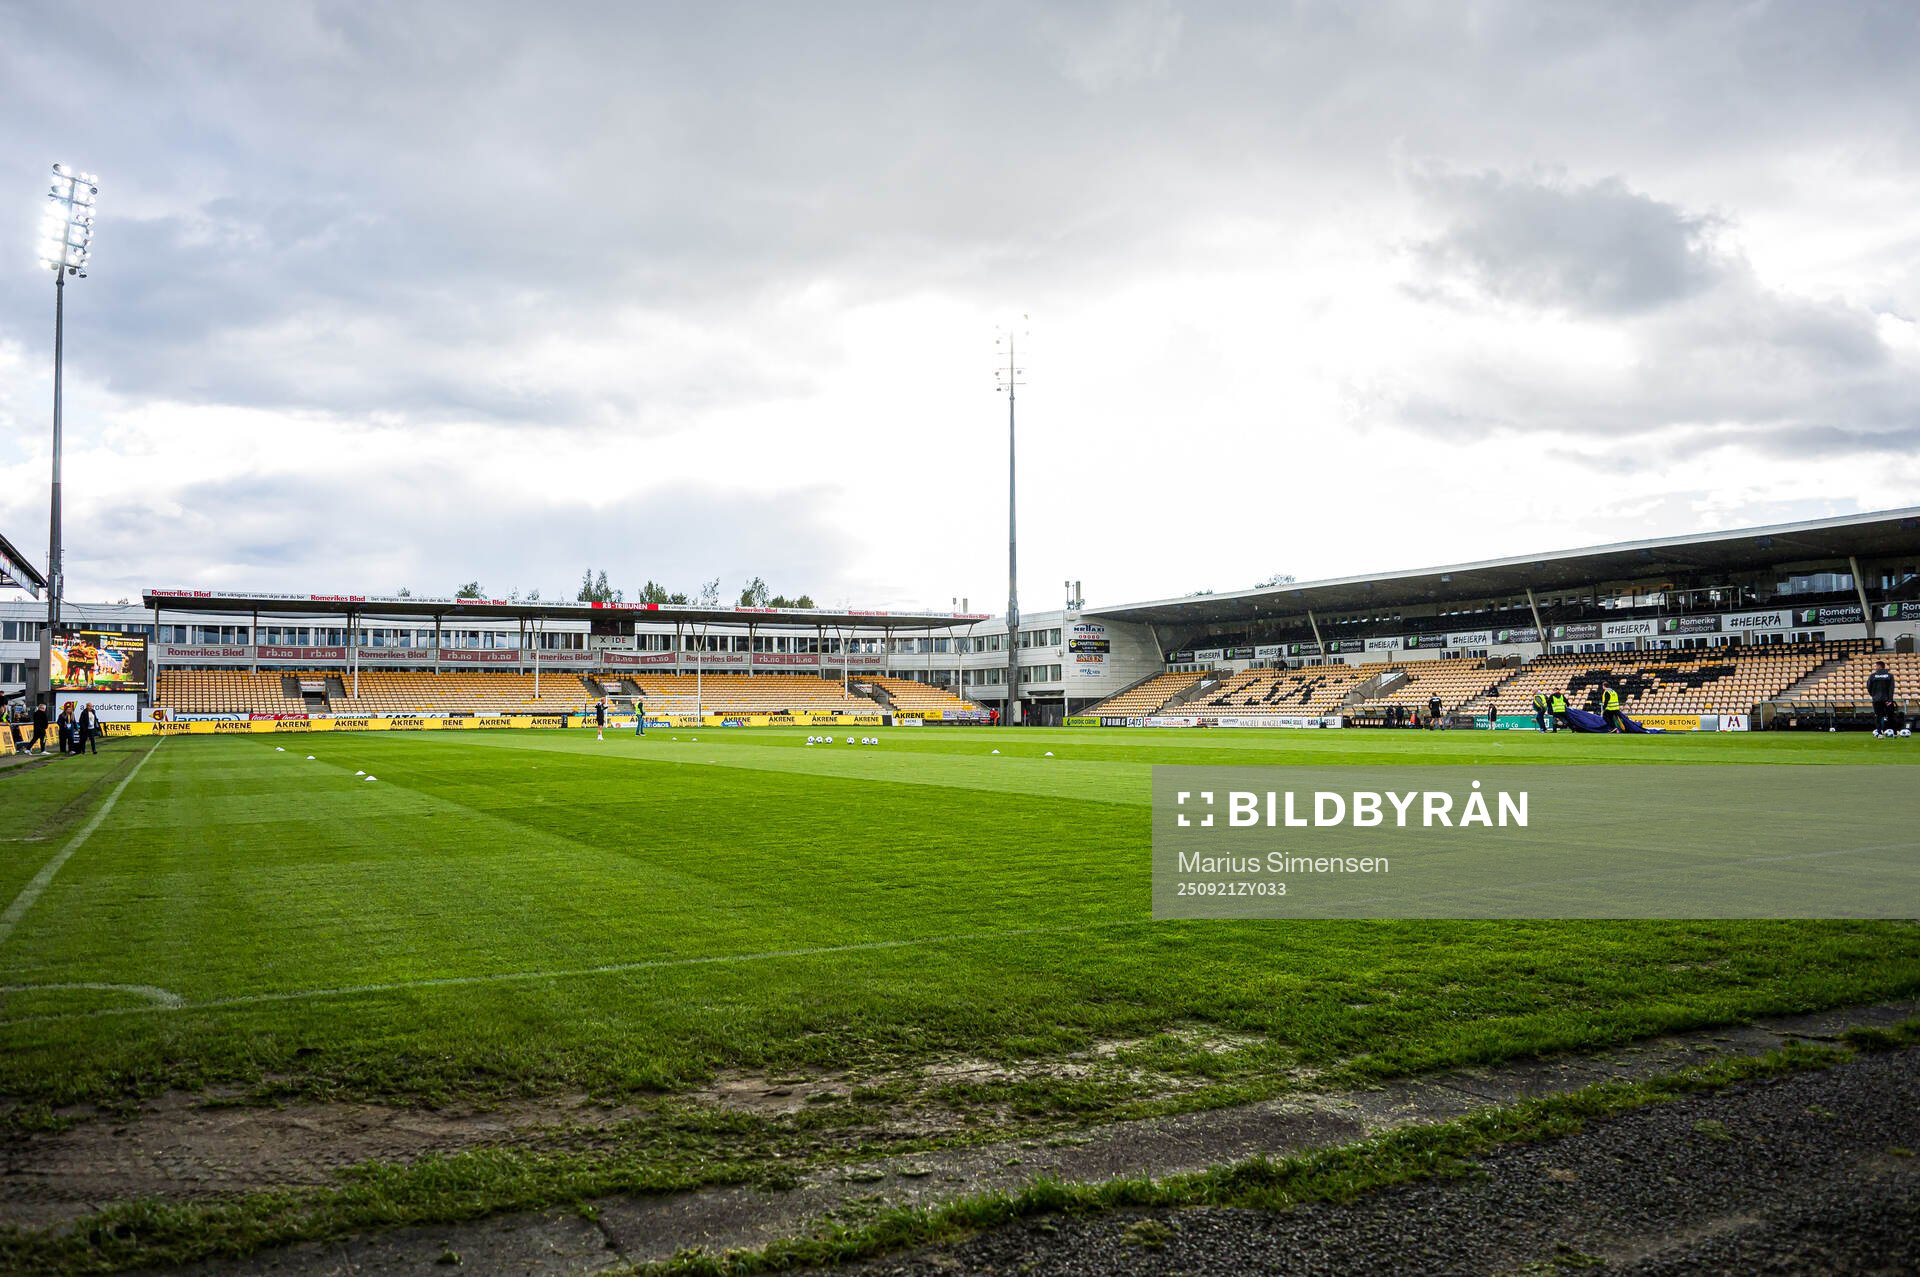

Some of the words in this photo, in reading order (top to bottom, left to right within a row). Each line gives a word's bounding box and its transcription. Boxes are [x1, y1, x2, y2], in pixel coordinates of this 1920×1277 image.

[151, 589, 192, 598] Romerikes
[1819, 607, 1862, 616] Romerike
[1680, 617, 1716, 625] Romerike
[1730, 612, 1782, 627] #HEIERPÅ
[1819, 615, 1862, 625] Sparebank
[1566, 625, 1597, 633] Romerike
[1607, 621, 1650, 634] #HEIERPÅ
[1680, 624, 1715, 633] Sparebank
[1452, 632, 1487, 644] #HEIERPÅ
[1566, 630, 1596, 639] Sparebank
[167, 647, 221, 656] Romerikes
[222, 648, 245, 656] Blad
[266, 648, 294, 657] rb.no
[310, 649, 337, 657] rb.no
[358, 650, 406, 659] Romerikes
[407, 650, 428, 659] Blad
[447, 651, 472, 660] rb.no
[487, 652, 512, 660] rb.no
[575, 653, 593, 661] Blad
[80, 703, 135, 711] arodukter.no
[105, 723, 131, 731] KRENE
